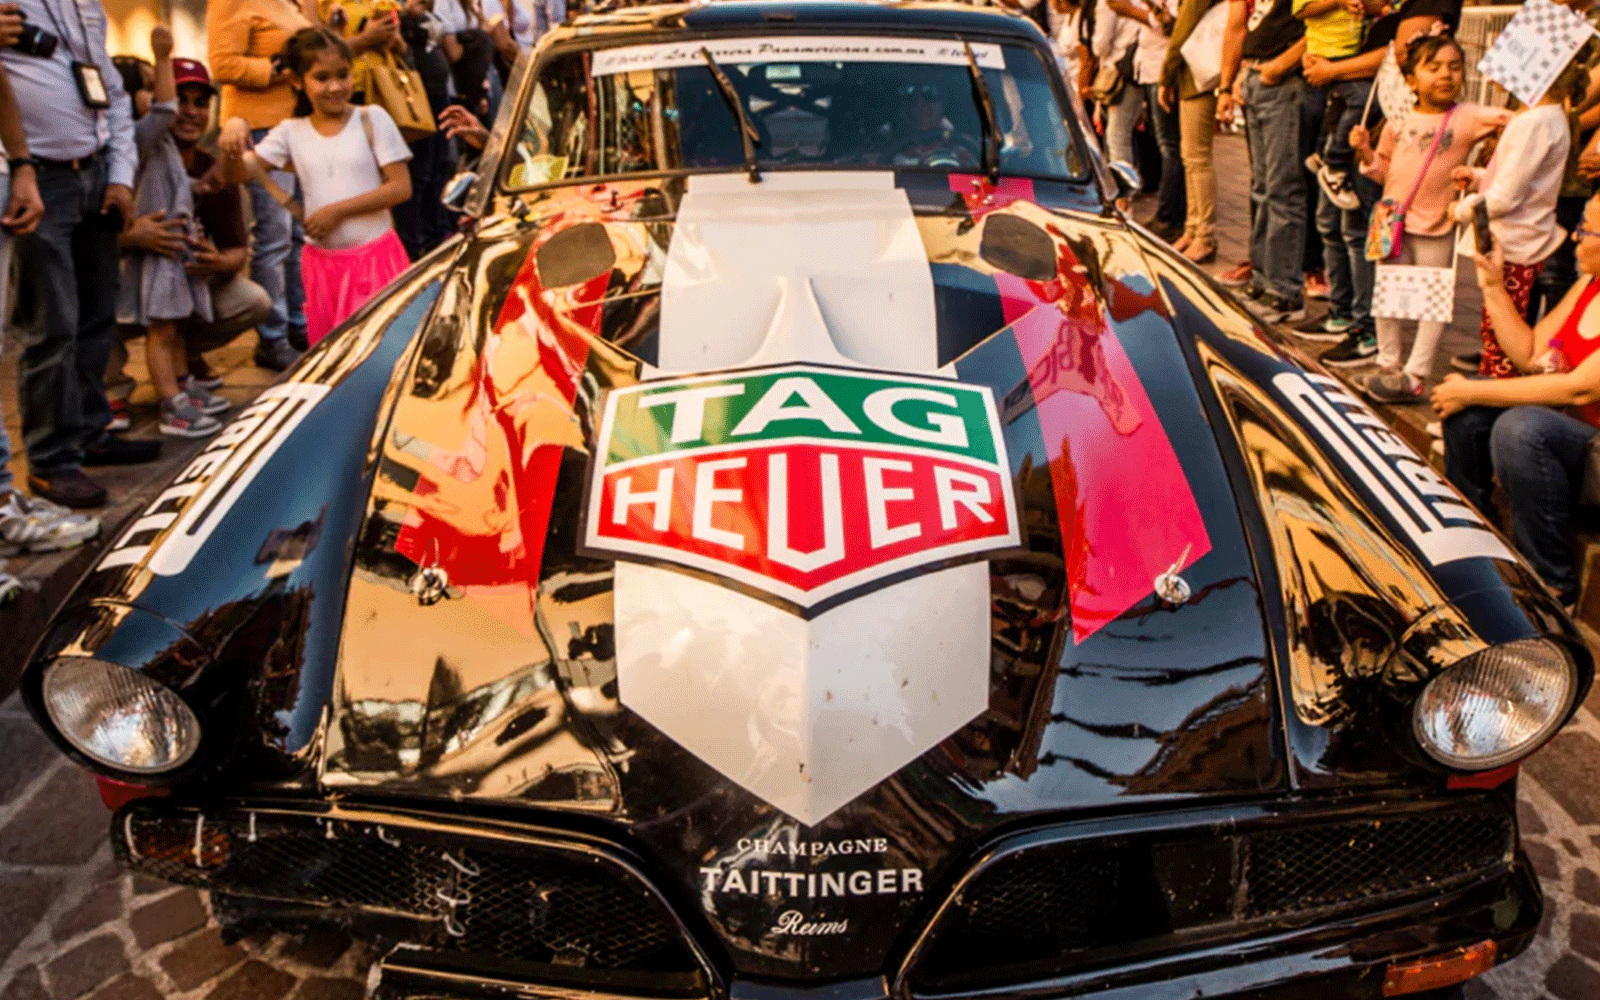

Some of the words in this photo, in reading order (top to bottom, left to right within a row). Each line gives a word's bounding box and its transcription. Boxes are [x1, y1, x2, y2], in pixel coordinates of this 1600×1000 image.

[690, 49, 752, 60] Crrera
[638, 376, 970, 448] TAG
[96, 382, 332, 576] PIRELLI
[1272, 371, 1518, 567] PIRELLI
[611, 452, 995, 573] HEUER
[736, 837, 888, 856] CHAMPAGNE
[699, 866, 925, 898] TAITTINGER
[770, 909, 849, 936] Reims
